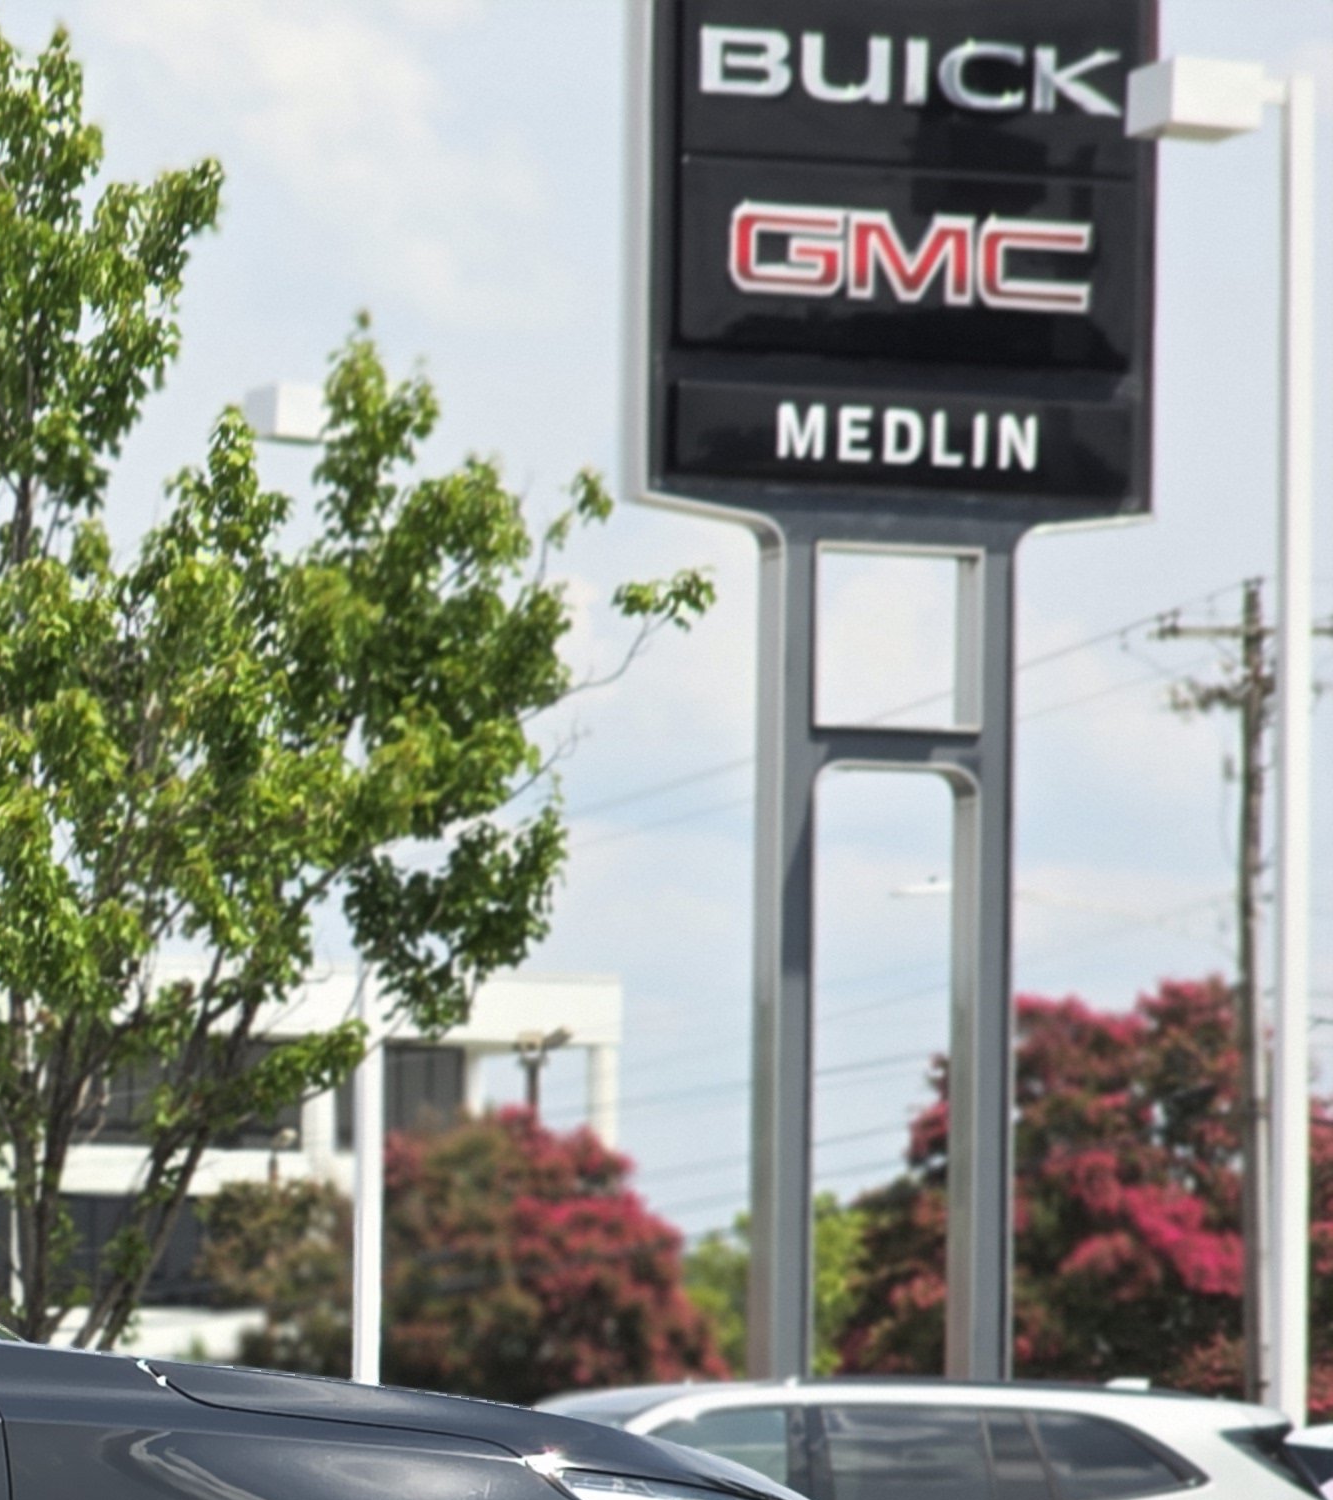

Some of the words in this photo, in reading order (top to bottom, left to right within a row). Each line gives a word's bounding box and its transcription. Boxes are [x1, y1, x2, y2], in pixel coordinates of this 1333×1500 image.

[699, 24, 1122, 118] BUICK
[728, 199, 1093, 314] GMC
[776, 402, 1038, 472] MEDLIN
